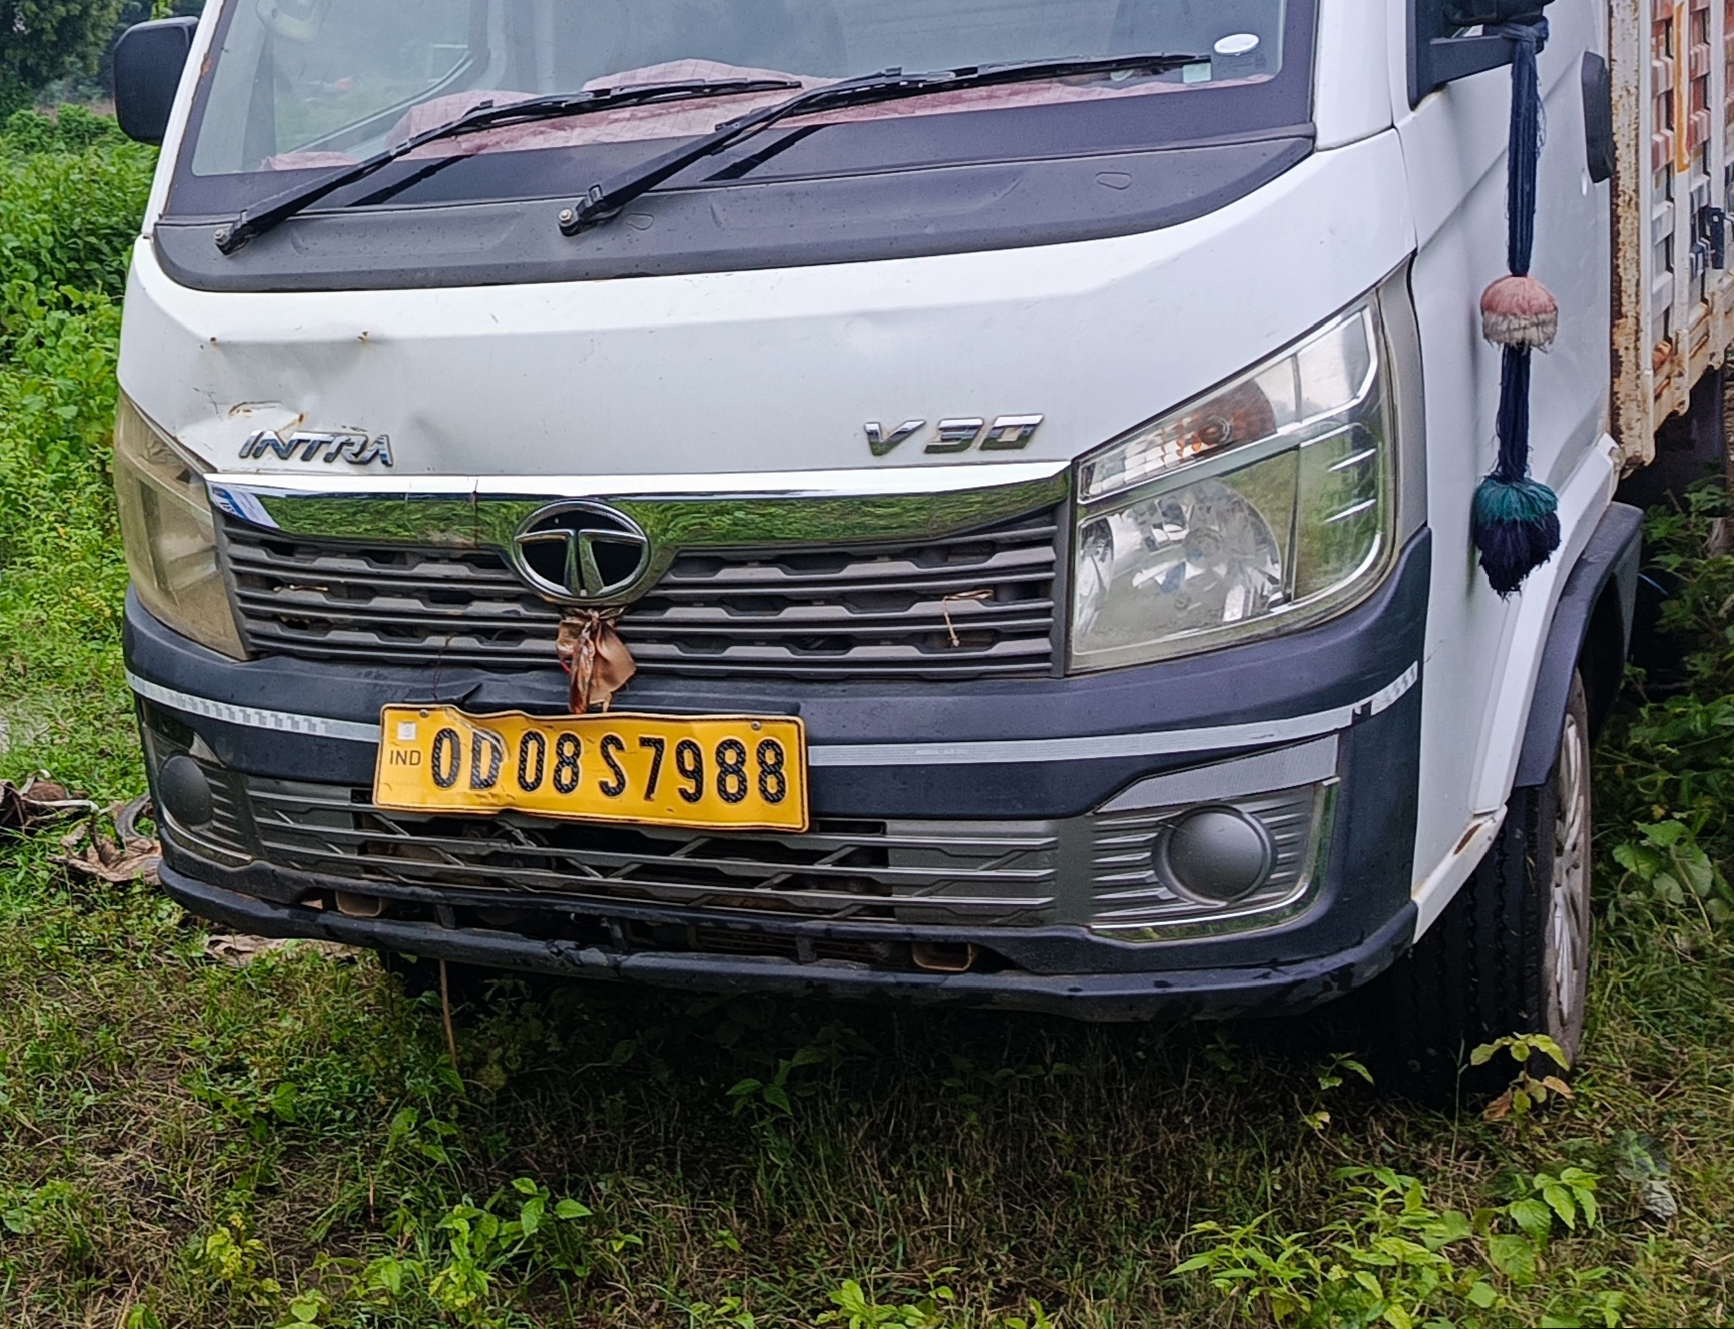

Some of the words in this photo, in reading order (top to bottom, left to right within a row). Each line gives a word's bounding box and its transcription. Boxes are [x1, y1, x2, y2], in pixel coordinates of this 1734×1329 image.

[238, 429, 393, 467] INTRA
[864, 413, 1044, 457] V30
[389, 749, 421, 766] IND
